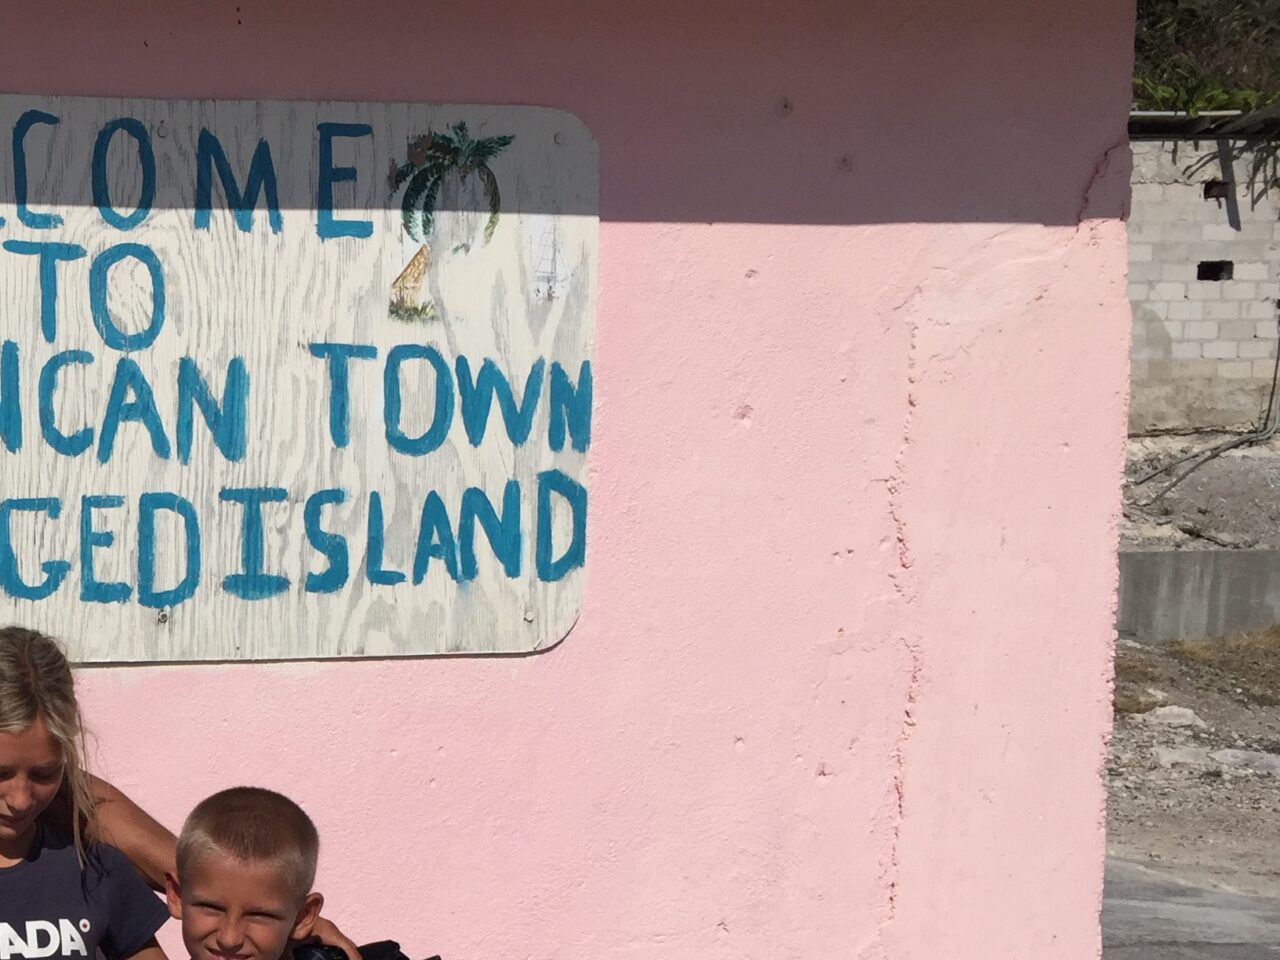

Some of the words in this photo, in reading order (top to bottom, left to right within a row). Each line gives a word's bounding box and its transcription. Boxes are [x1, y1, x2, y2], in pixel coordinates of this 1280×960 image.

[3, 239, 165, 351] TO
[310, 342, 592, 456] TOWN
[219, 469, 588, 601] ISLAND
